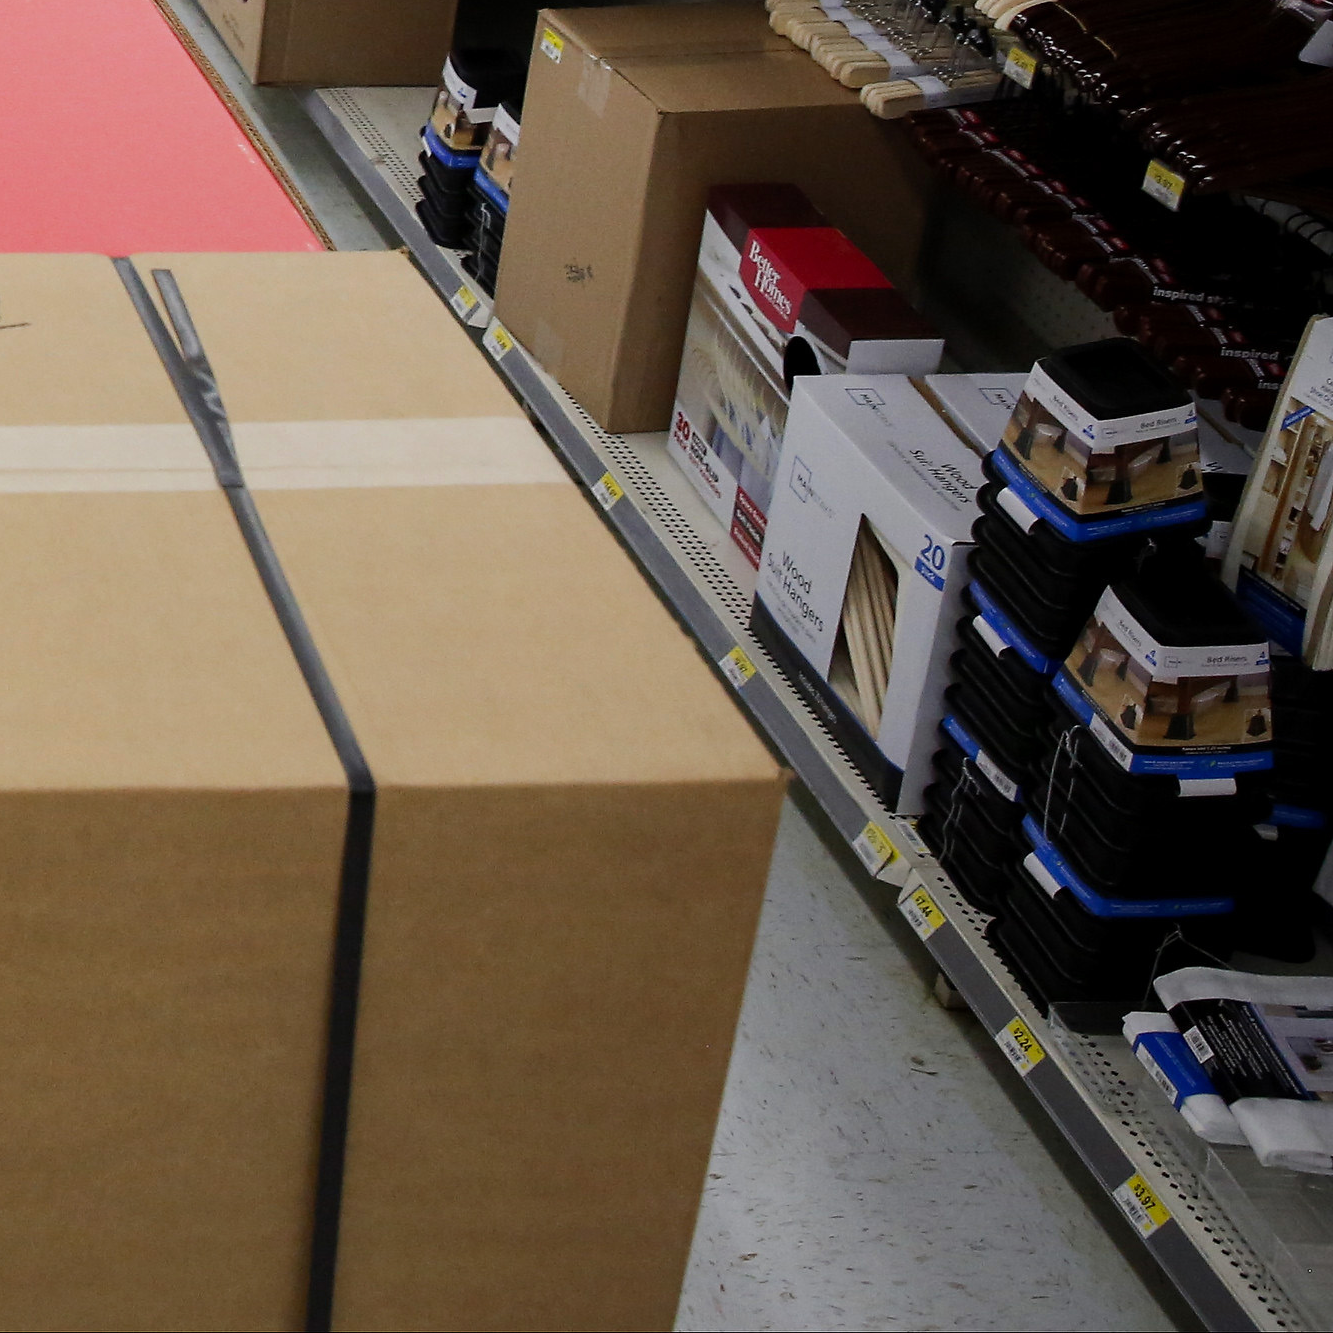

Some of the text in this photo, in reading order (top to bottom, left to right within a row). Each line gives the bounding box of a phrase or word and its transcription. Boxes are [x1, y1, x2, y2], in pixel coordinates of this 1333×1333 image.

[750, 239, 782, 284] Better
[754, 271, 793, 316] Homes
[1152, 286, 1205, 301] inspired
[1220, 347, 1280, 363] inspired
[929, 466, 974, 503] Hangers
[941, 462, 979, 490] Wood
[919, 533, 946, 571] 20
[782, 549, 813, 595] Wood
[782, 575, 825, 633] Hangers
[1012, 1026, 1033, 1054] $2.24
[1132, 1182, 1157, 1210] $3.97
